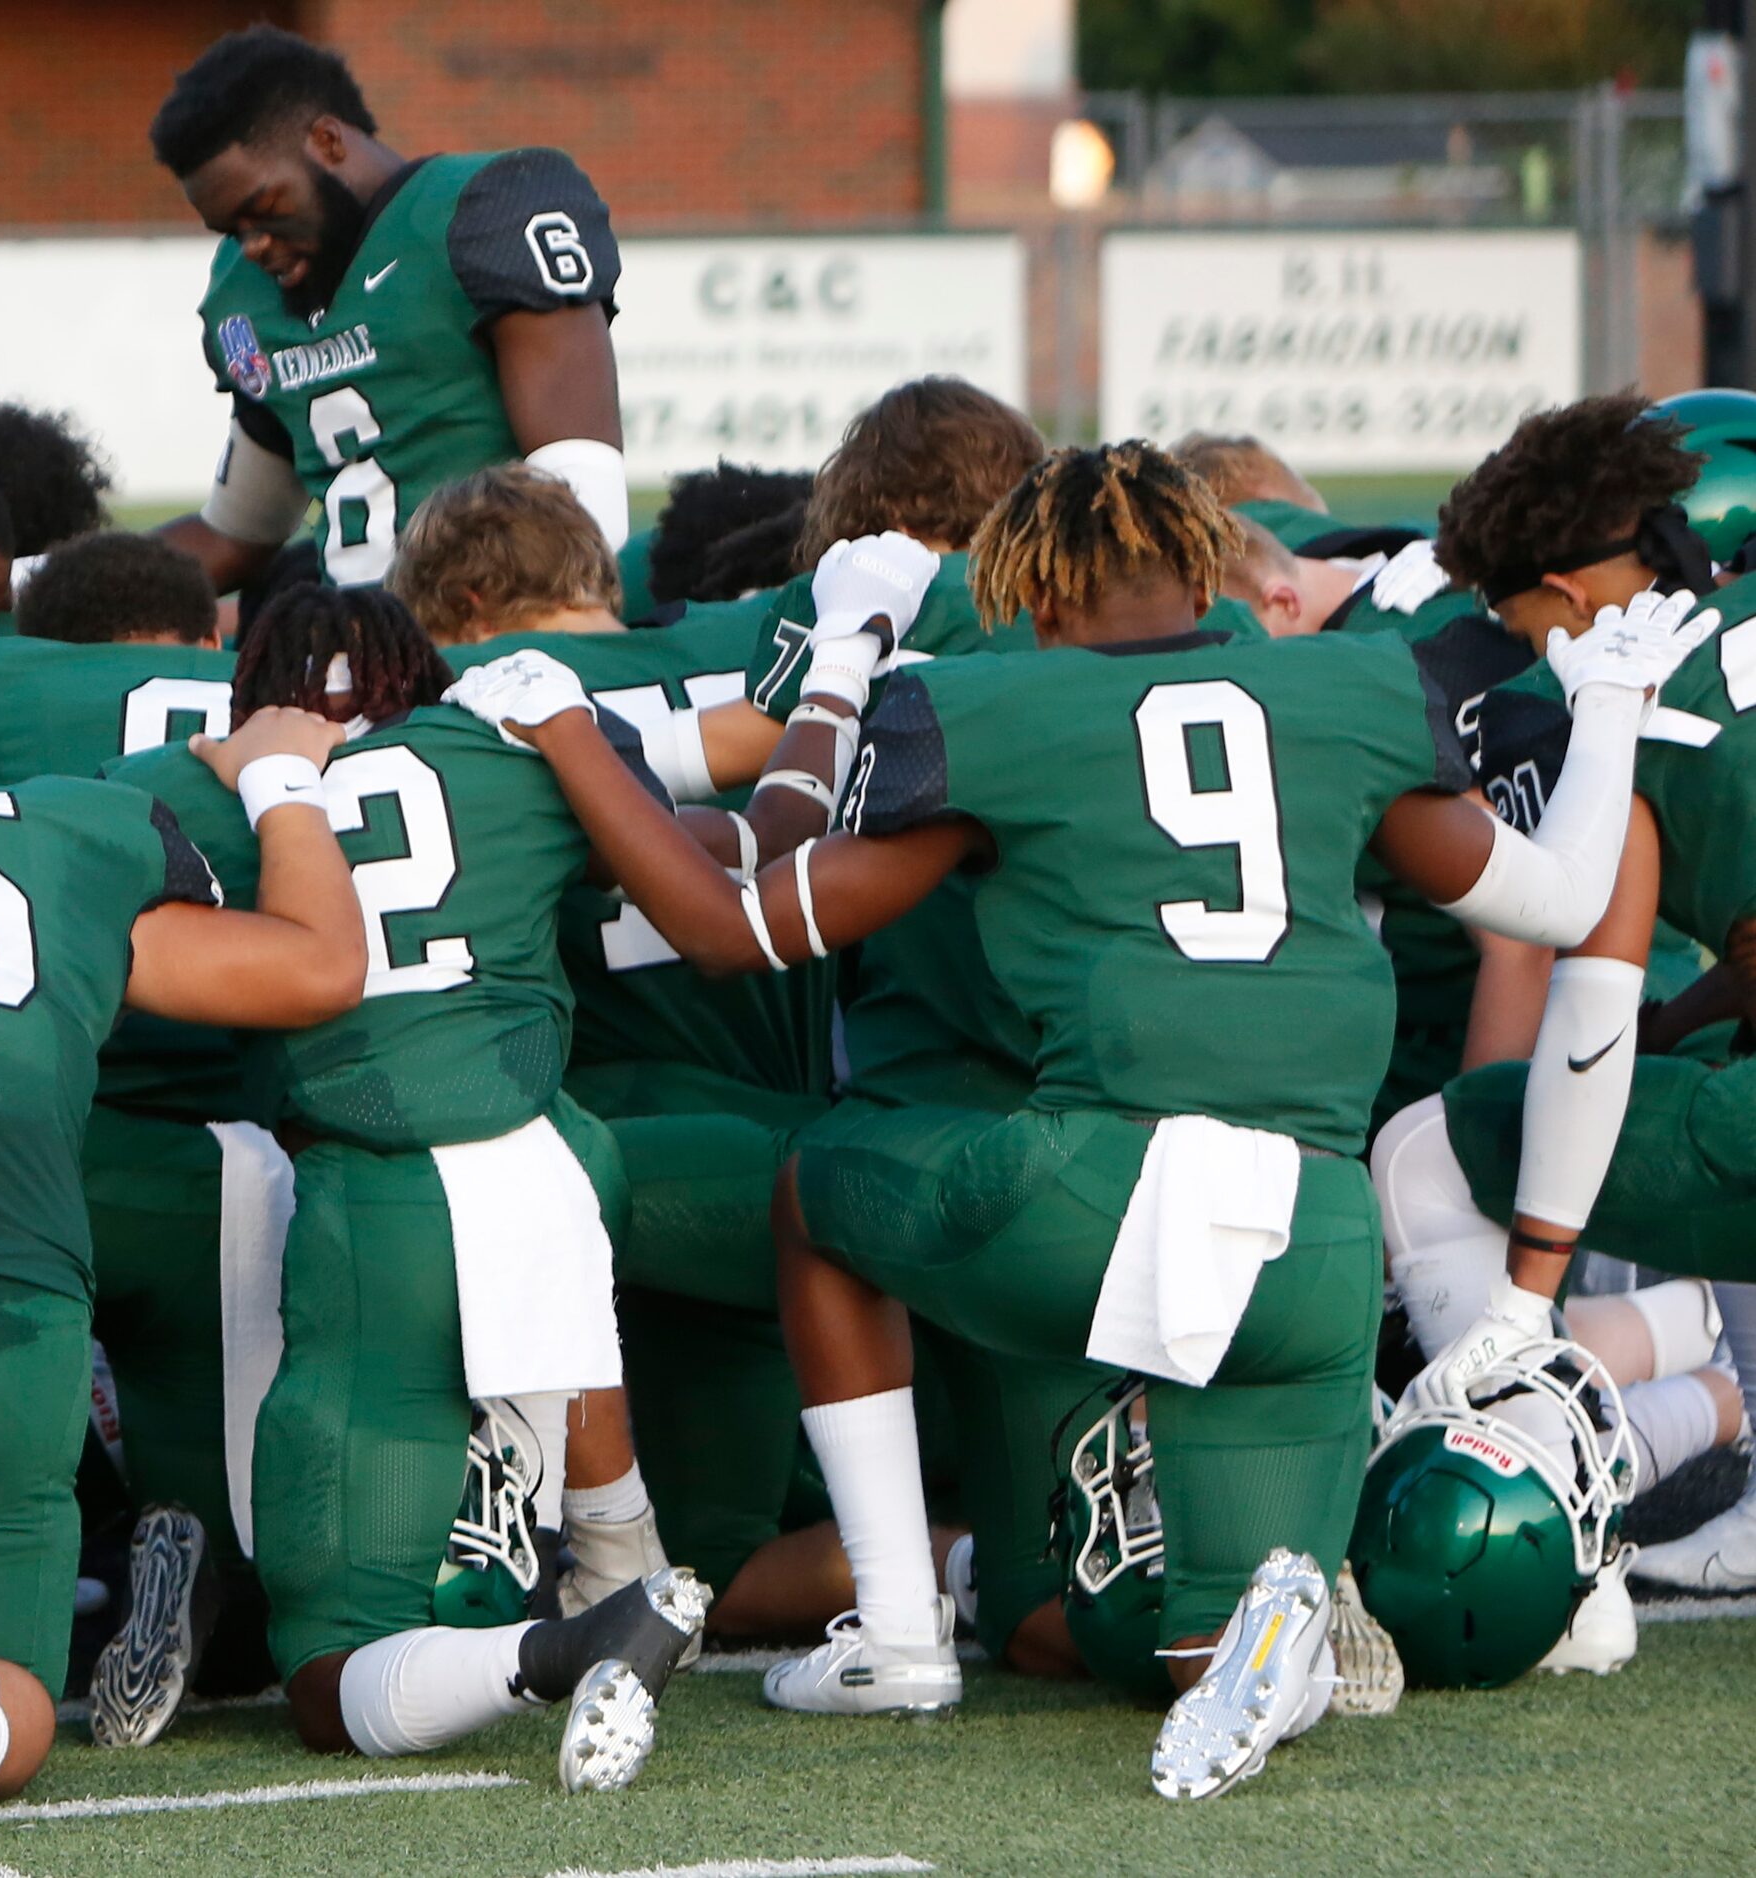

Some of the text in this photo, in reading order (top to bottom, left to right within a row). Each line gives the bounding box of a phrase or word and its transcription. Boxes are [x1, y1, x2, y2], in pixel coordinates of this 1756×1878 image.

[524, 210, 593, 295] 6
[270, 322, 377, 392] KENNEDALE
[1154, 308, 1529, 369] FABRICATION
[308, 385, 398, 587] 6
[1131, 679, 1293, 965] 9
[1450, 1431, 1512, 1470] Riddell
